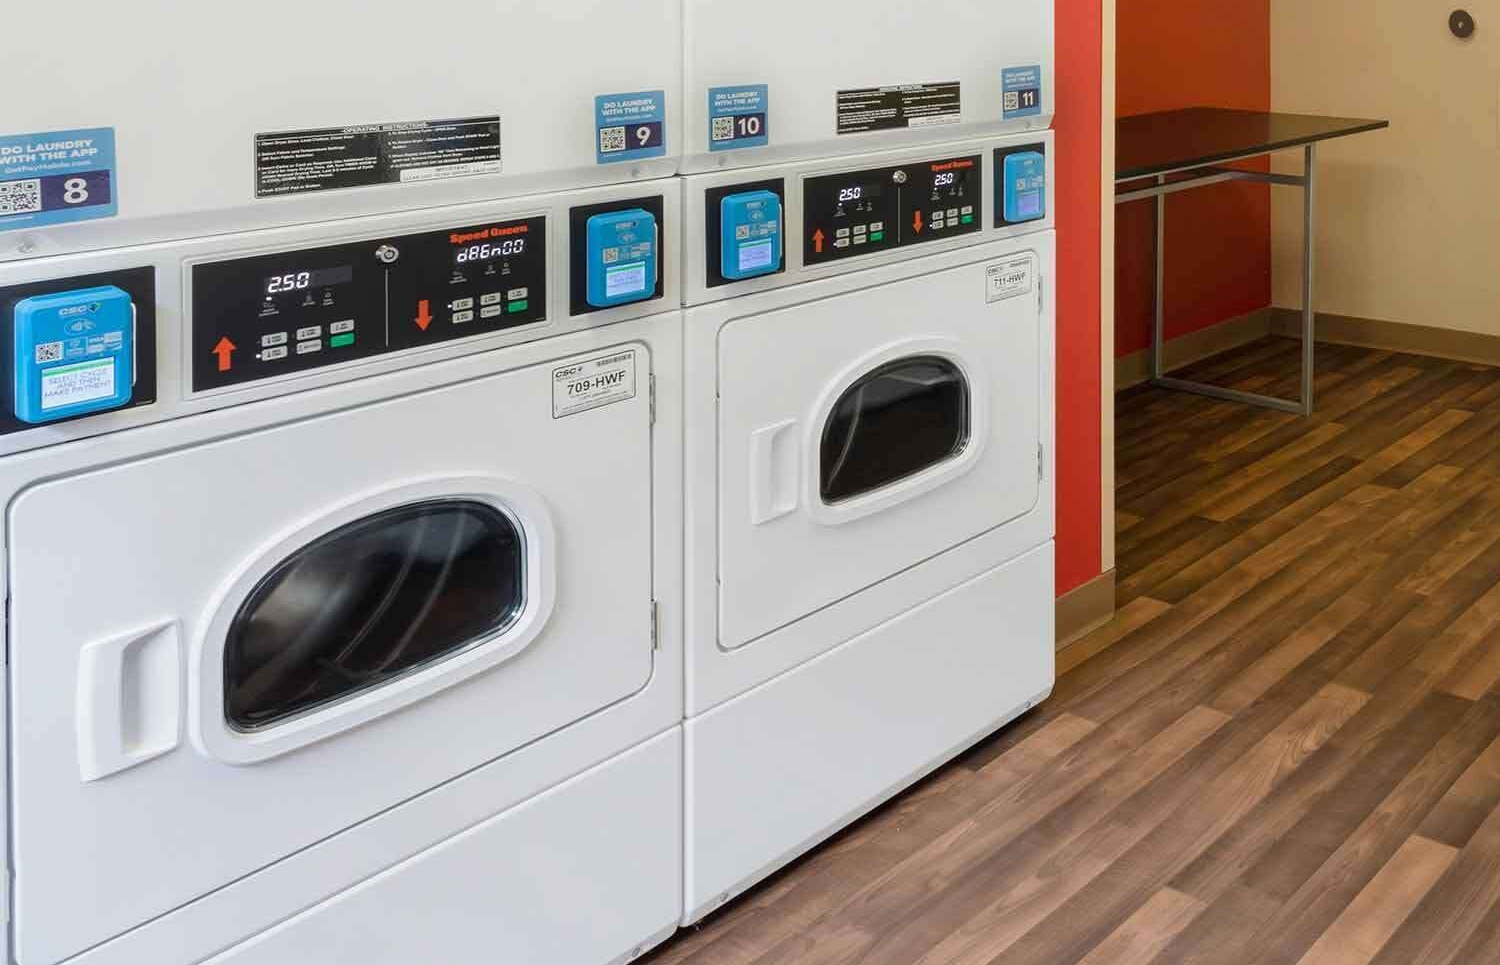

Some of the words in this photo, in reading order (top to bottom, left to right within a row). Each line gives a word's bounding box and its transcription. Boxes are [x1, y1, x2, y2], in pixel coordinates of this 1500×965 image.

[603, 101, 616, 109] DO
[617, 99, 653, 108] LAUNDRY
[1022, 91, 1034, 106] 11
[601, 107, 622, 117] WITH
[624, 106, 639, 115] THE
[738, 117, 760, 136] 10
[636, 126, 651, 146] 9
[1, 146, 23, 155] DO
[27, 139, 94, 153] LAUNDRY
[38, 150, 67, 161] THE
[71, 147, 98, 158] APP
[63, 177, 89, 204] 8
[450, 229, 489, 245] Speed
[490, 224, 528, 237] Queen
[267, 271, 310, 293] 2.50
[58, 304, 88, 316] CSC
[555, 367, 577, 379] CSC
[567, 369, 626, 394] 709-HWF
